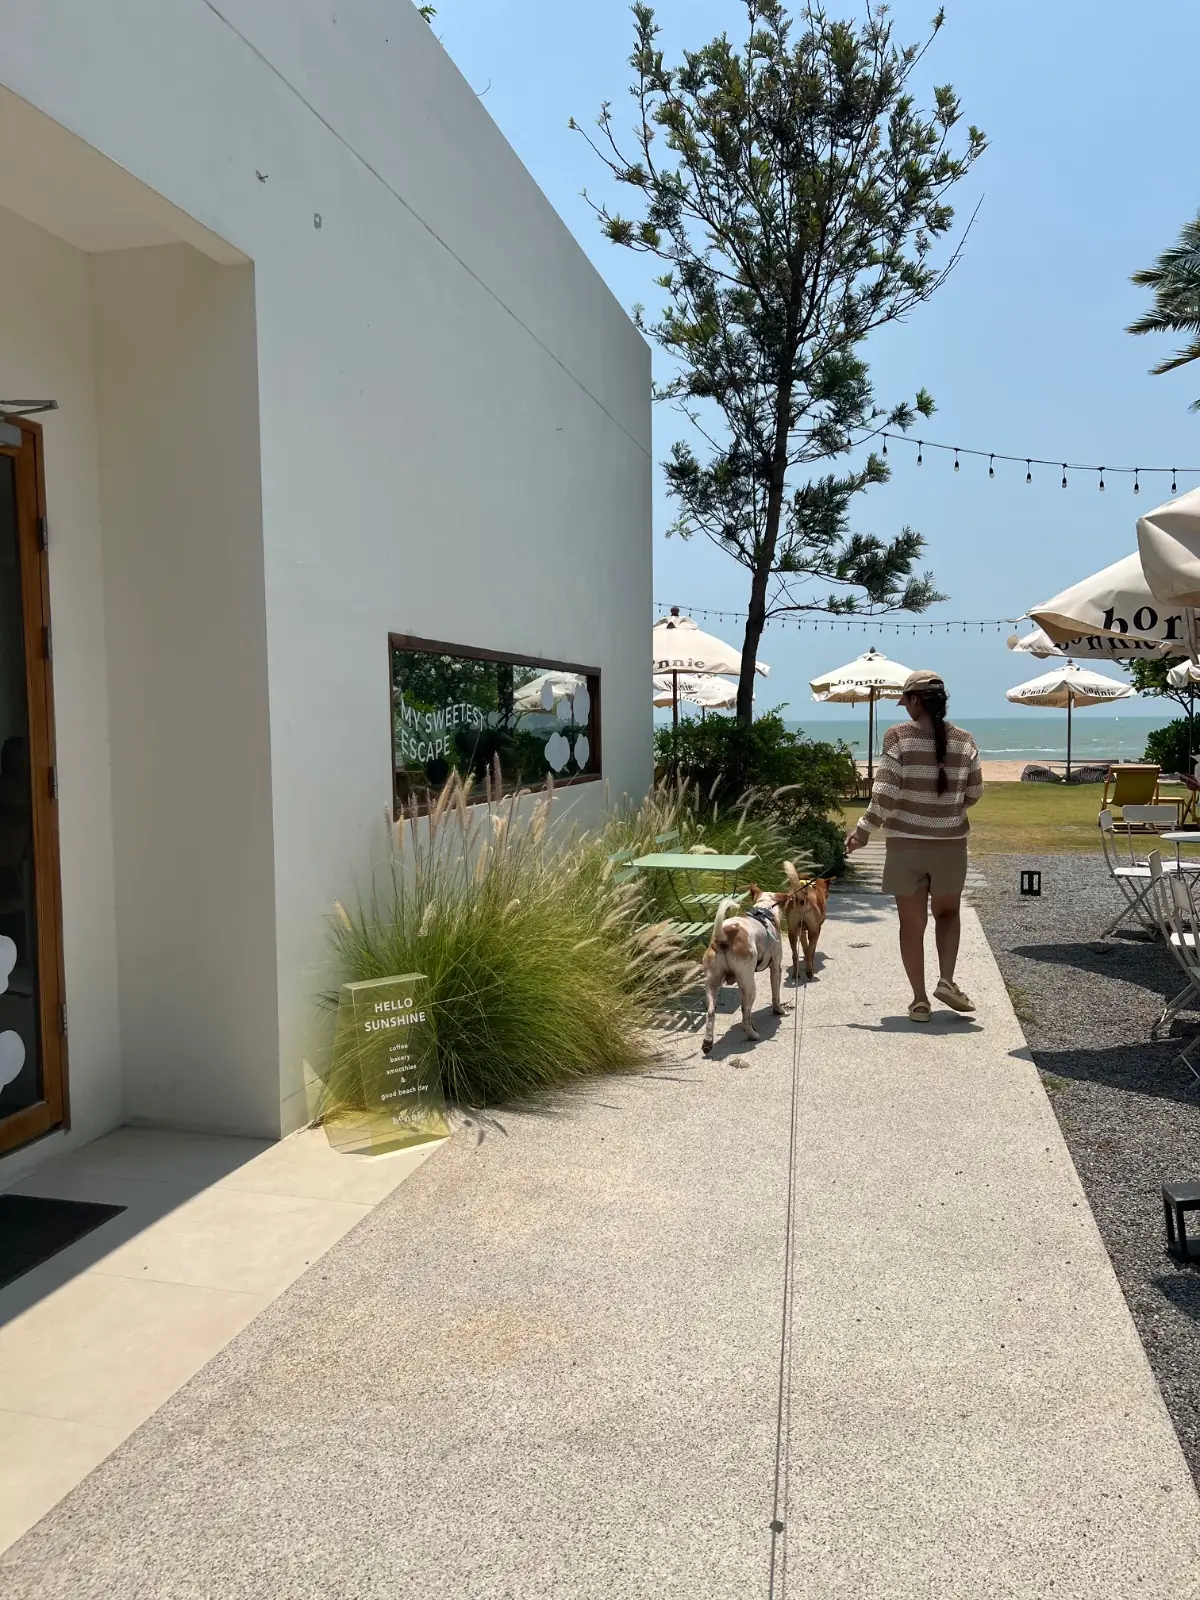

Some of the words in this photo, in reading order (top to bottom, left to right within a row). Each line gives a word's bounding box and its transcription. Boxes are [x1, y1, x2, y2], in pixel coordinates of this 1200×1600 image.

[1102, 605, 1200, 641] bon
[838, 678, 886, 686] bonnie
[1083, 686, 1117, 697] bonnie
[401, 698, 420, 732] MY
[425, 703, 485, 733] SWEETEST
[401, 729, 451, 763] ESCAPE
[374, 997, 413, 1013] HELLO
[364, 1012, 426, 1032] SUNSHINE
[389, 1043, 408, 1052] coffee
[389, 1054, 411, 1063] bakery
[386, 1064, 417, 1075] smoothies
[381, 1090, 397, 1101] good
[398, 1086, 417, 1096] beach
[417, 1083, 429, 1092] day
